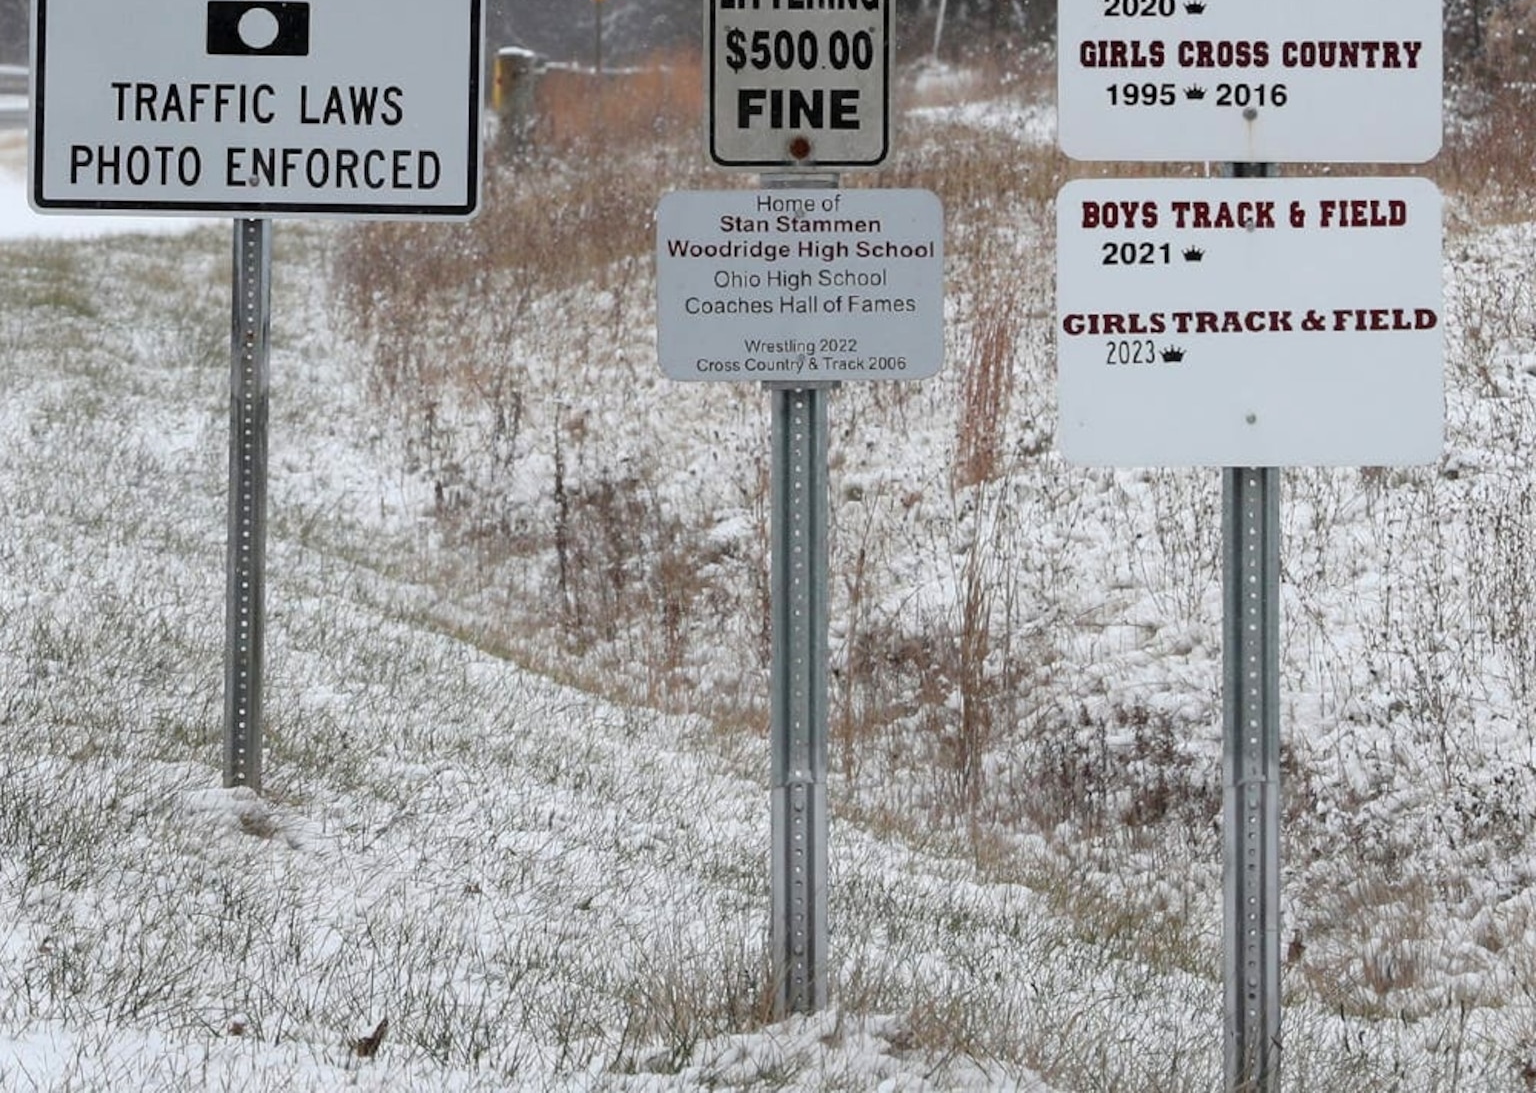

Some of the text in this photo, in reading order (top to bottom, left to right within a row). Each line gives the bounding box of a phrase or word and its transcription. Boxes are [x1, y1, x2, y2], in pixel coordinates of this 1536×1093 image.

[726, 28, 873, 74] $500.00
[1080, 41, 1422, 68] GIRLS CROSS COUNTRY
[112, 83, 404, 126] TRAFFIC LAWS
[1107, 84, 1287, 106] 1995 2016
[738, 90, 860, 129] FINE
[71, 145, 440, 189] PHOTO ENFORCED
[757, 194, 842, 212] Home of
[1082, 200, 1406, 228] BOYS TRACK & FIELD
[720, 216, 880, 233] Stan Stammen
[668, 241, 934, 261] Woodridge High School
[1102, 242, 1171, 265] 2021
[714, 269, 886, 290] Ohio High School
[686, 295, 915, 314] Coaches Hall of Fames
[1063, 309, 1437, 336] GIRLS TRACK & FIELD
[745, 339, 857, 355] Wrestling 2022
[1106, 341, 1156, 365] 2023
[697, 357, 906, 374] Cross Country & Track 2006
